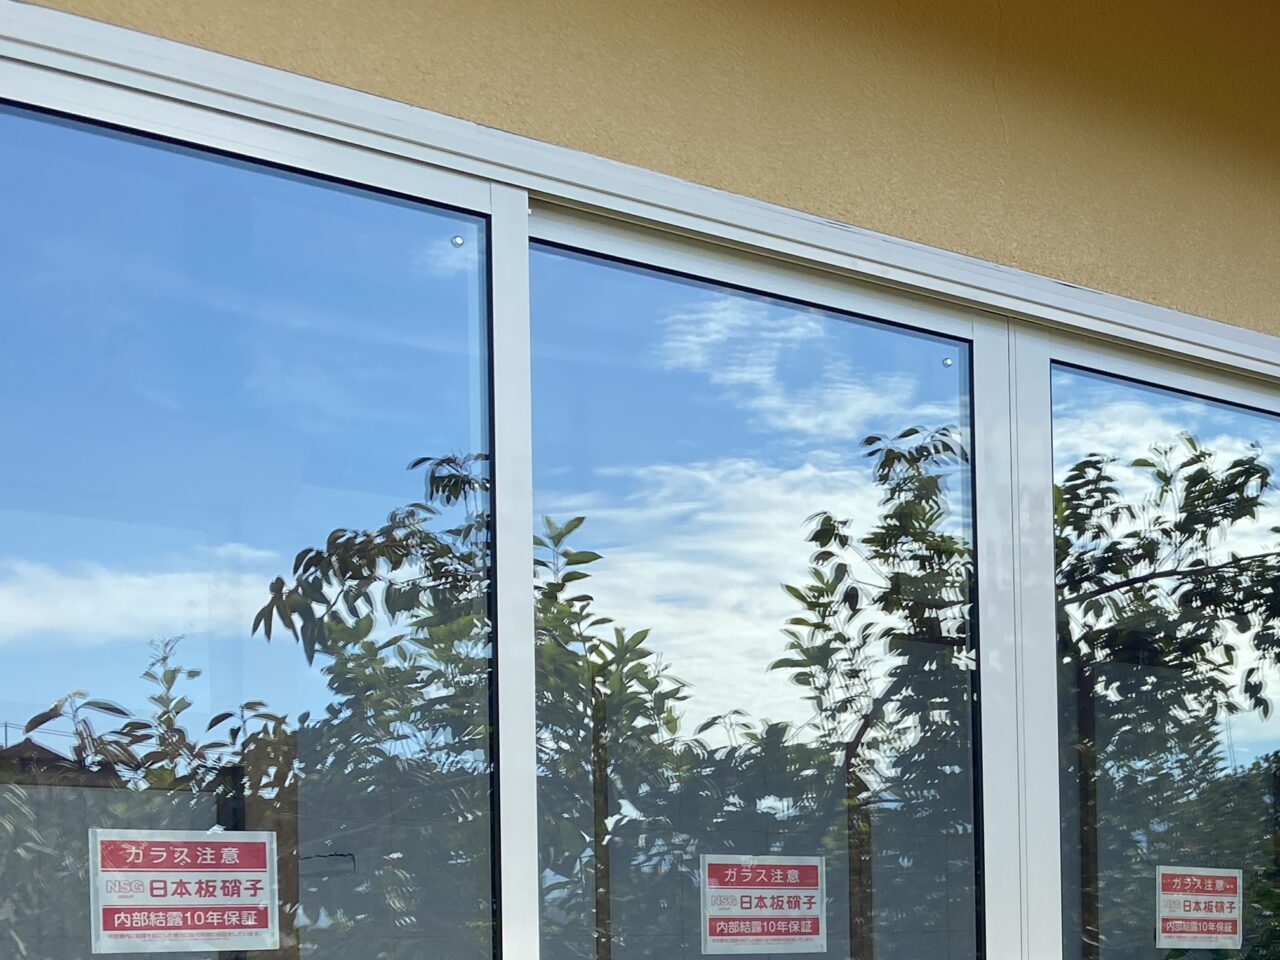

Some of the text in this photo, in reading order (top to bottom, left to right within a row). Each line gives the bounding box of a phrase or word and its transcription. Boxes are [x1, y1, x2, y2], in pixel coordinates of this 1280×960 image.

[125, 846, 240, 865] ガラス注意
[724, 868, 800, 883] ガラス注意
[105, 879, 264, 898] NSG 日本板硝子
[1172, 878, 1225, 891] ガラス注意
[740, 895, 817, 910] 日本板硝子
[1183, 900, 1236, 913] 日本板硝子
[114, 910, 258, 928] 内部結露10年保証
[716, 920, 813, 934] 内部結露10年保証
